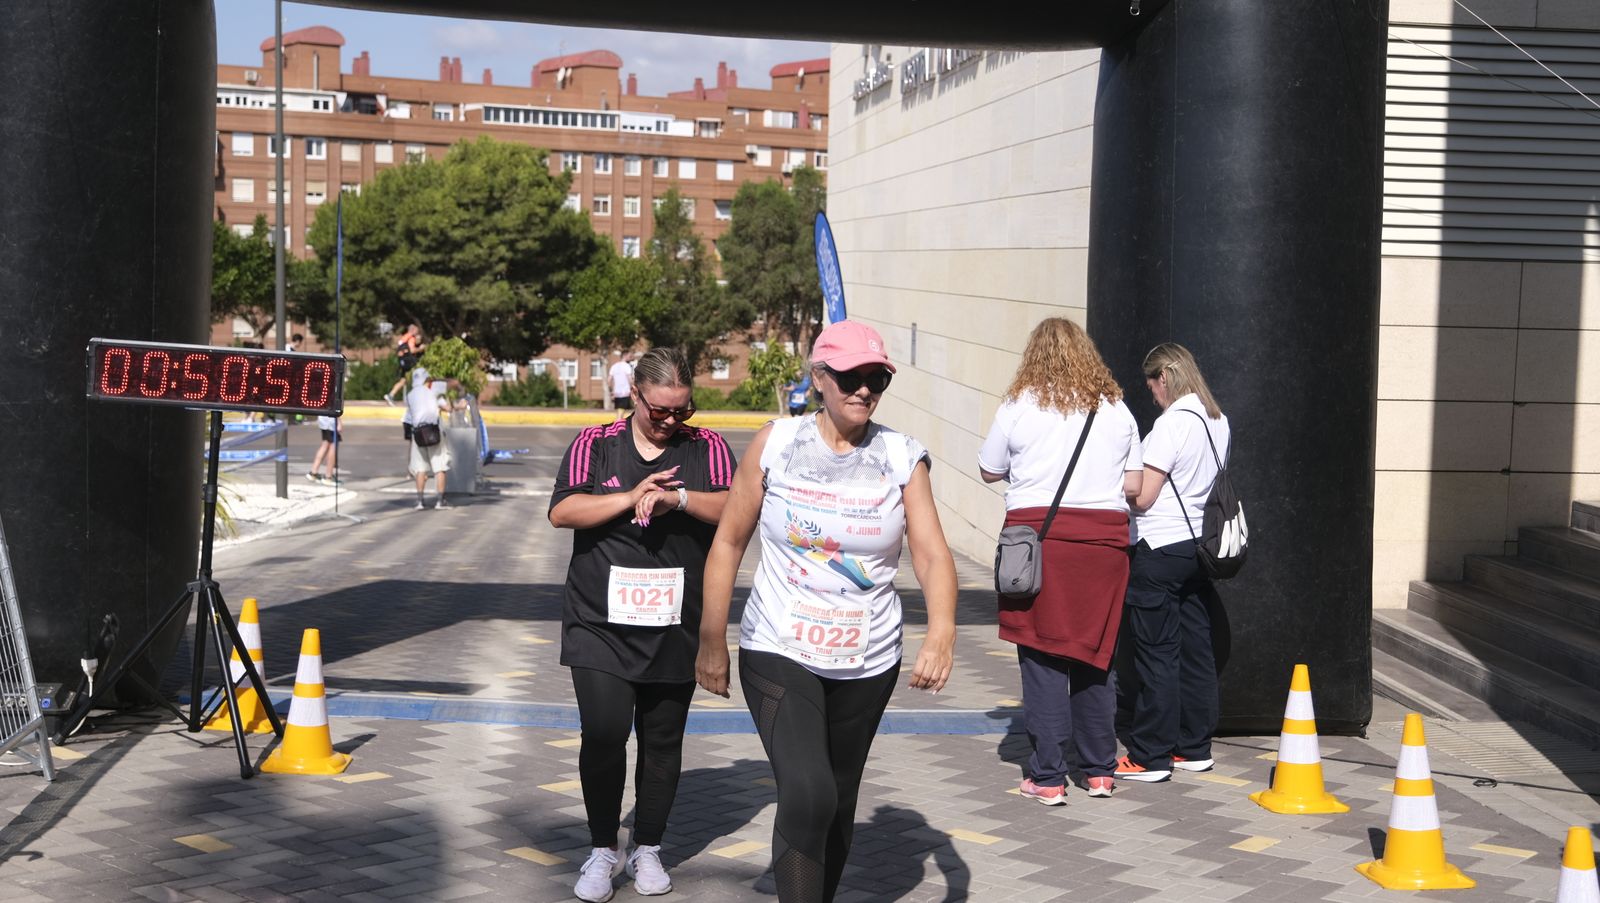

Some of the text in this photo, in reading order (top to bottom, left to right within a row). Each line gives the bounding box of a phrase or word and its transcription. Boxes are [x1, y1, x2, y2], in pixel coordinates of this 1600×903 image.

[102, 348, 330, 407] 00:50:50
[856, 526, 881, 536] JUNIO
[617, 587, 674, 606] 1021
[791, 621, 861, 648] 1022
